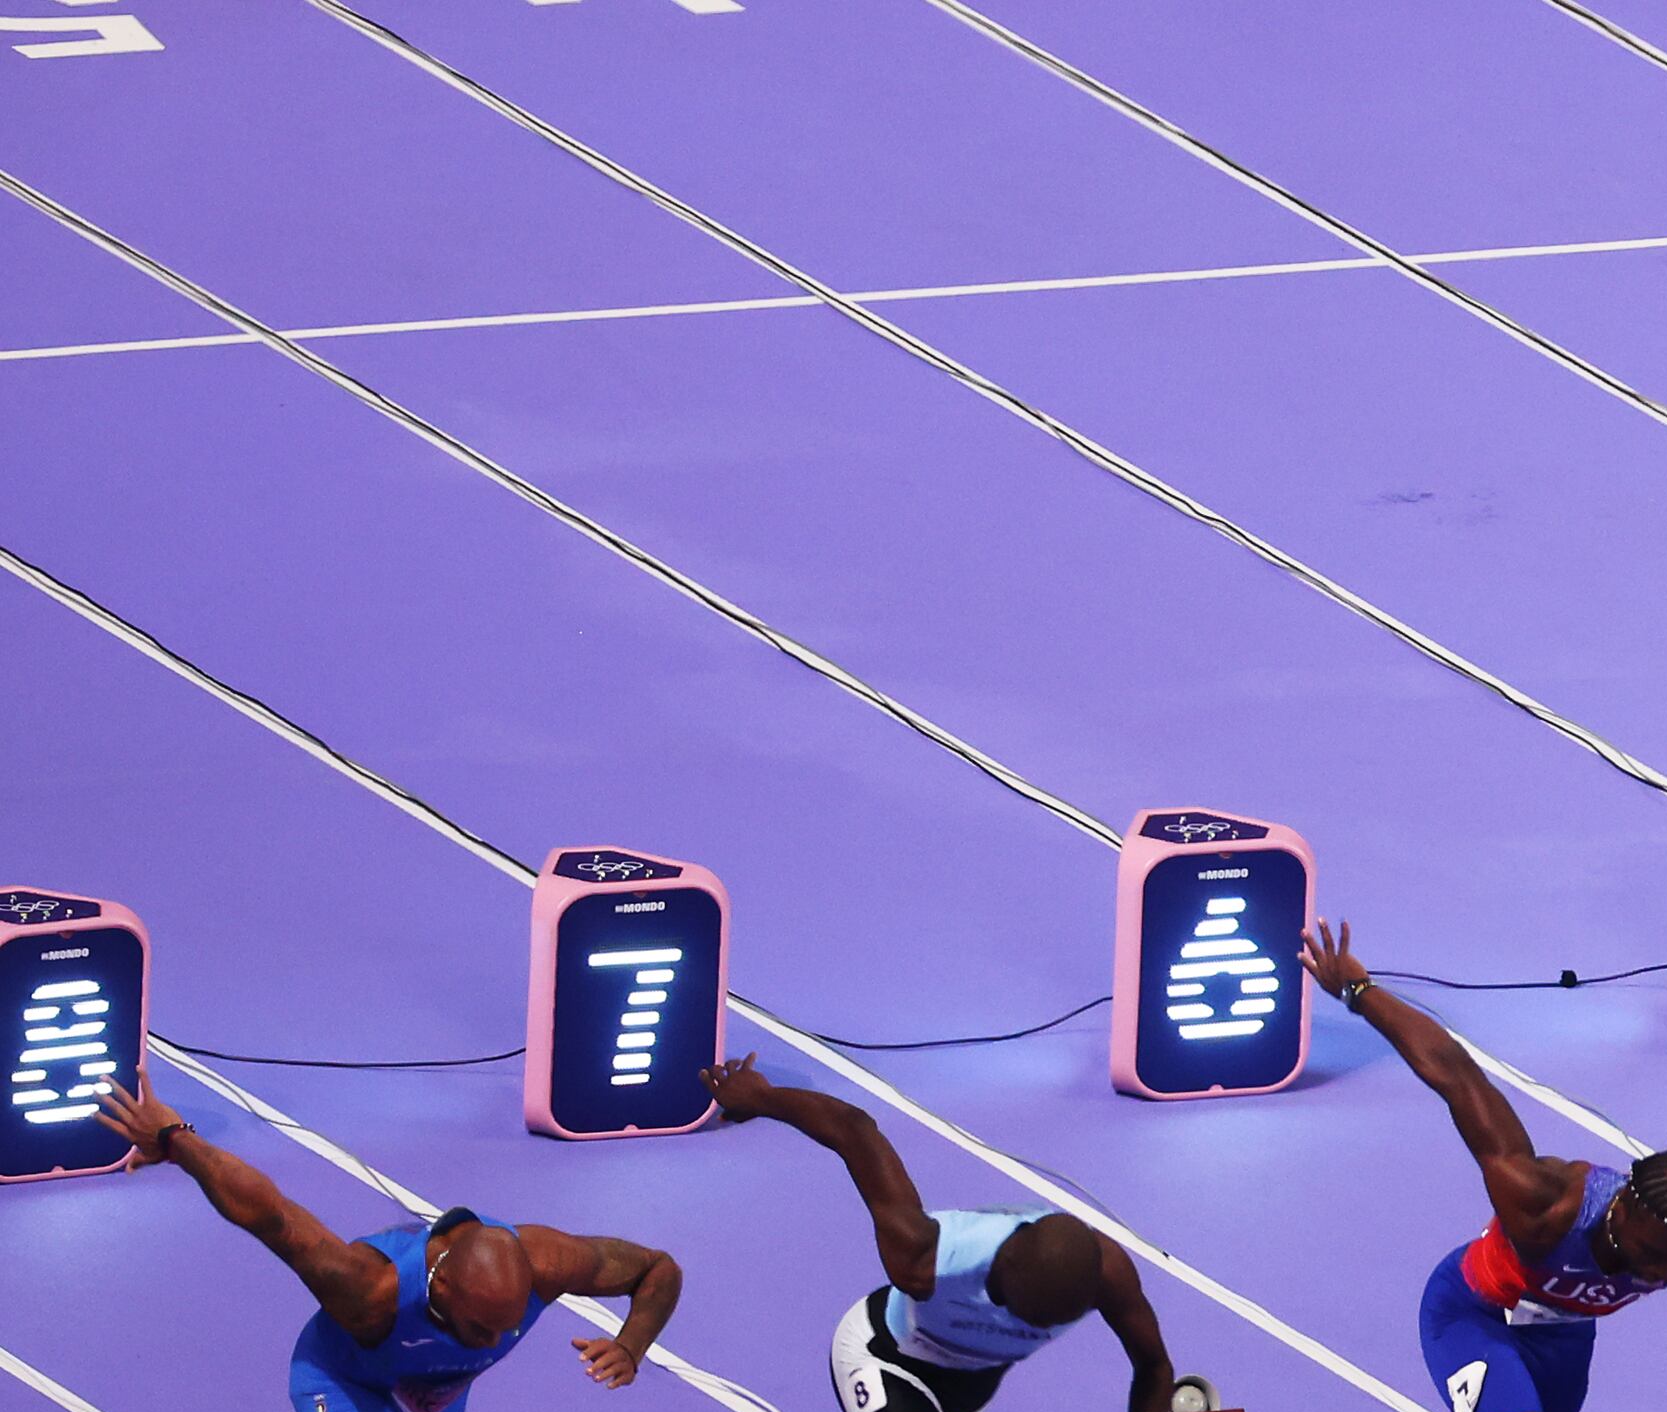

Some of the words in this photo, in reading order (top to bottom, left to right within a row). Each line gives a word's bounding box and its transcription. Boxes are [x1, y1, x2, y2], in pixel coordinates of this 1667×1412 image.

[1206, 868, 1249, 880] MONDO
[623, 902, 666, 913] MONDO
[50, 947, 90, 960] MONDO
[1166, 897, 1279, 1040] 6
[588, 948, 682, 1085] 7
[11, 980, 117, 1124] 8
[852, 1382, 871, 1410] 8
